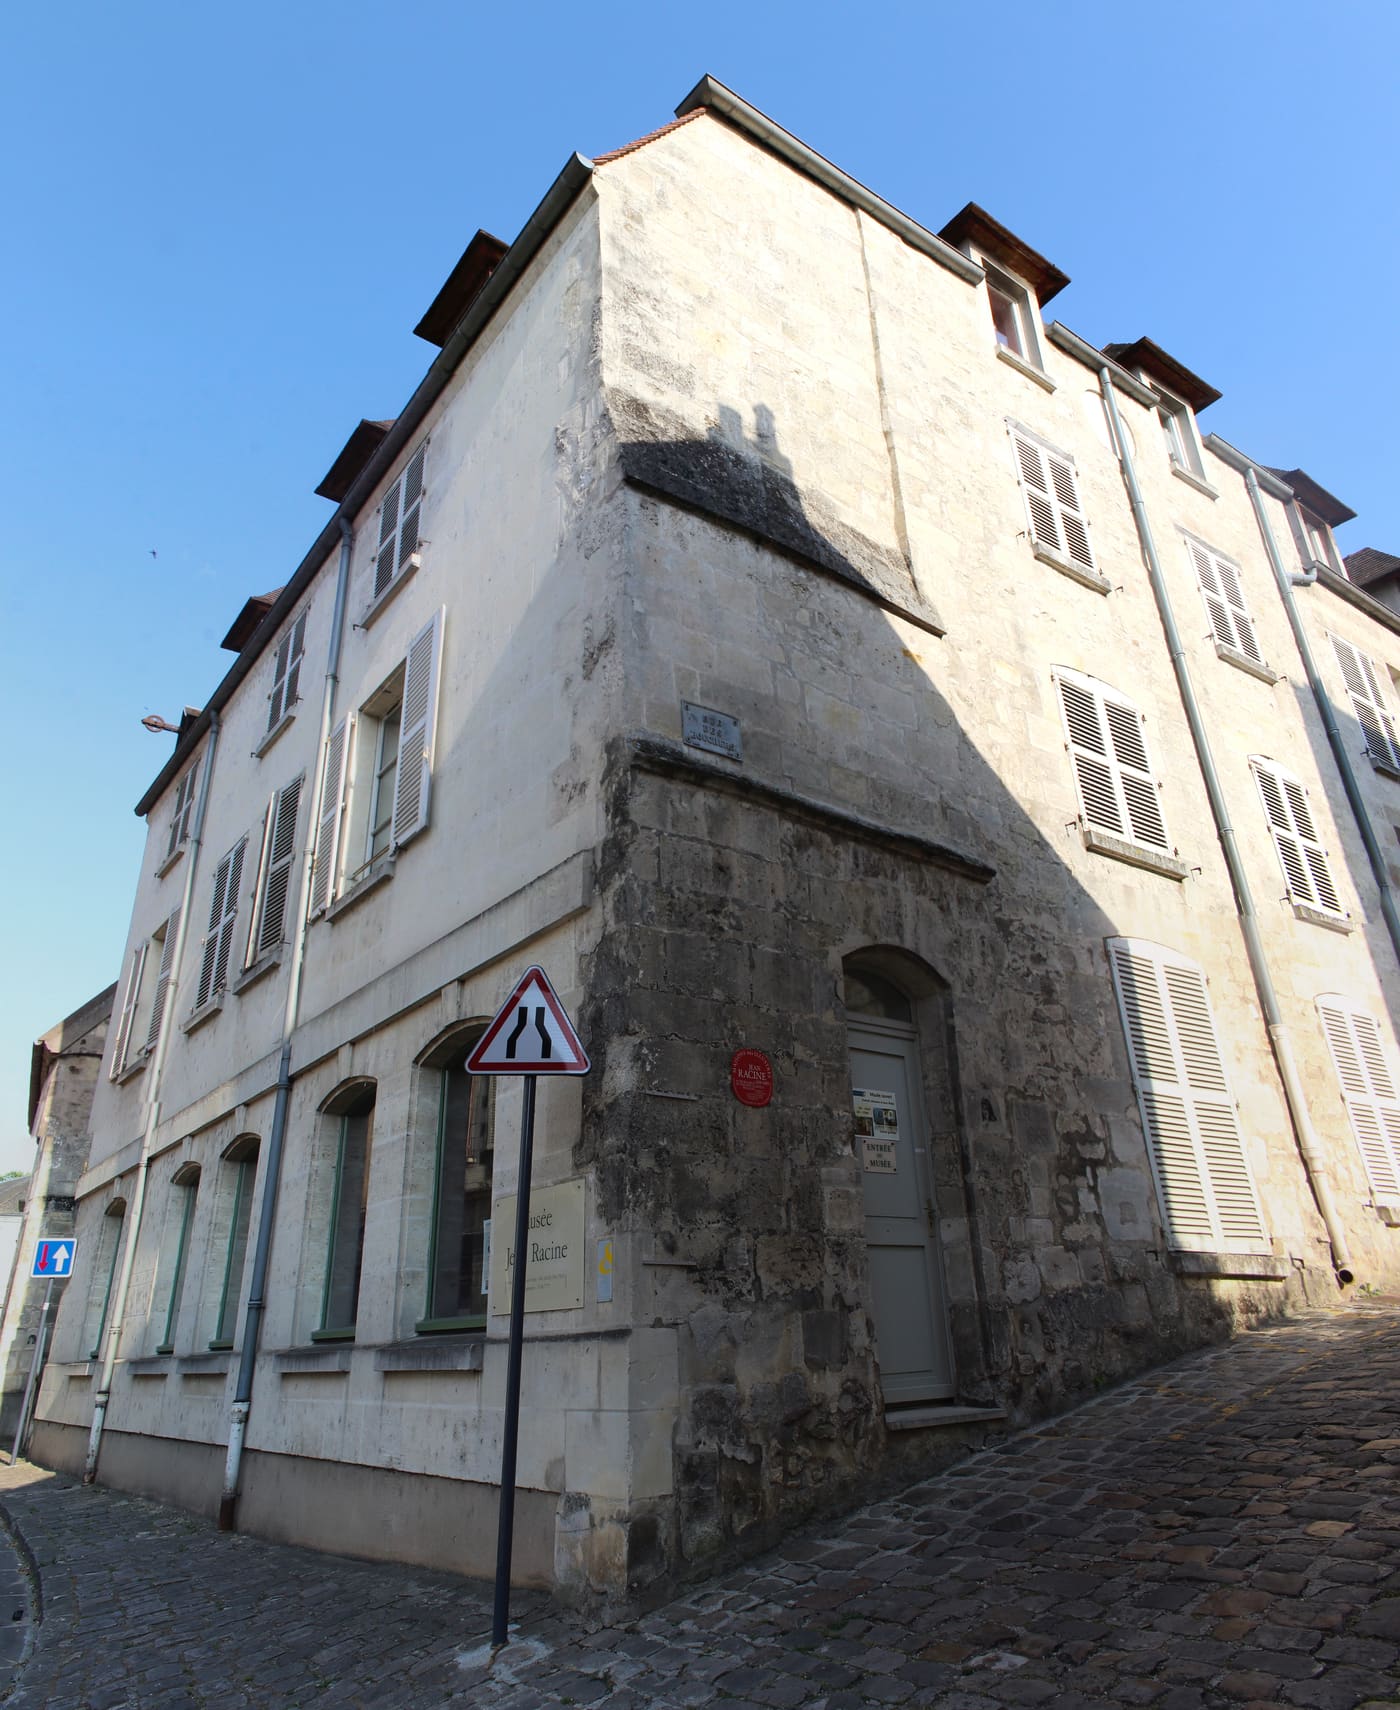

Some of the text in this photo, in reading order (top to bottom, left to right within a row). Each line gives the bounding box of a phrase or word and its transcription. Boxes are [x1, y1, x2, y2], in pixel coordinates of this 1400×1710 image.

[738, 1069, 767, 1081] RACINE
[527, 1208, 553, 1230] usée
[531, 1241, 569, 1263] Racine
